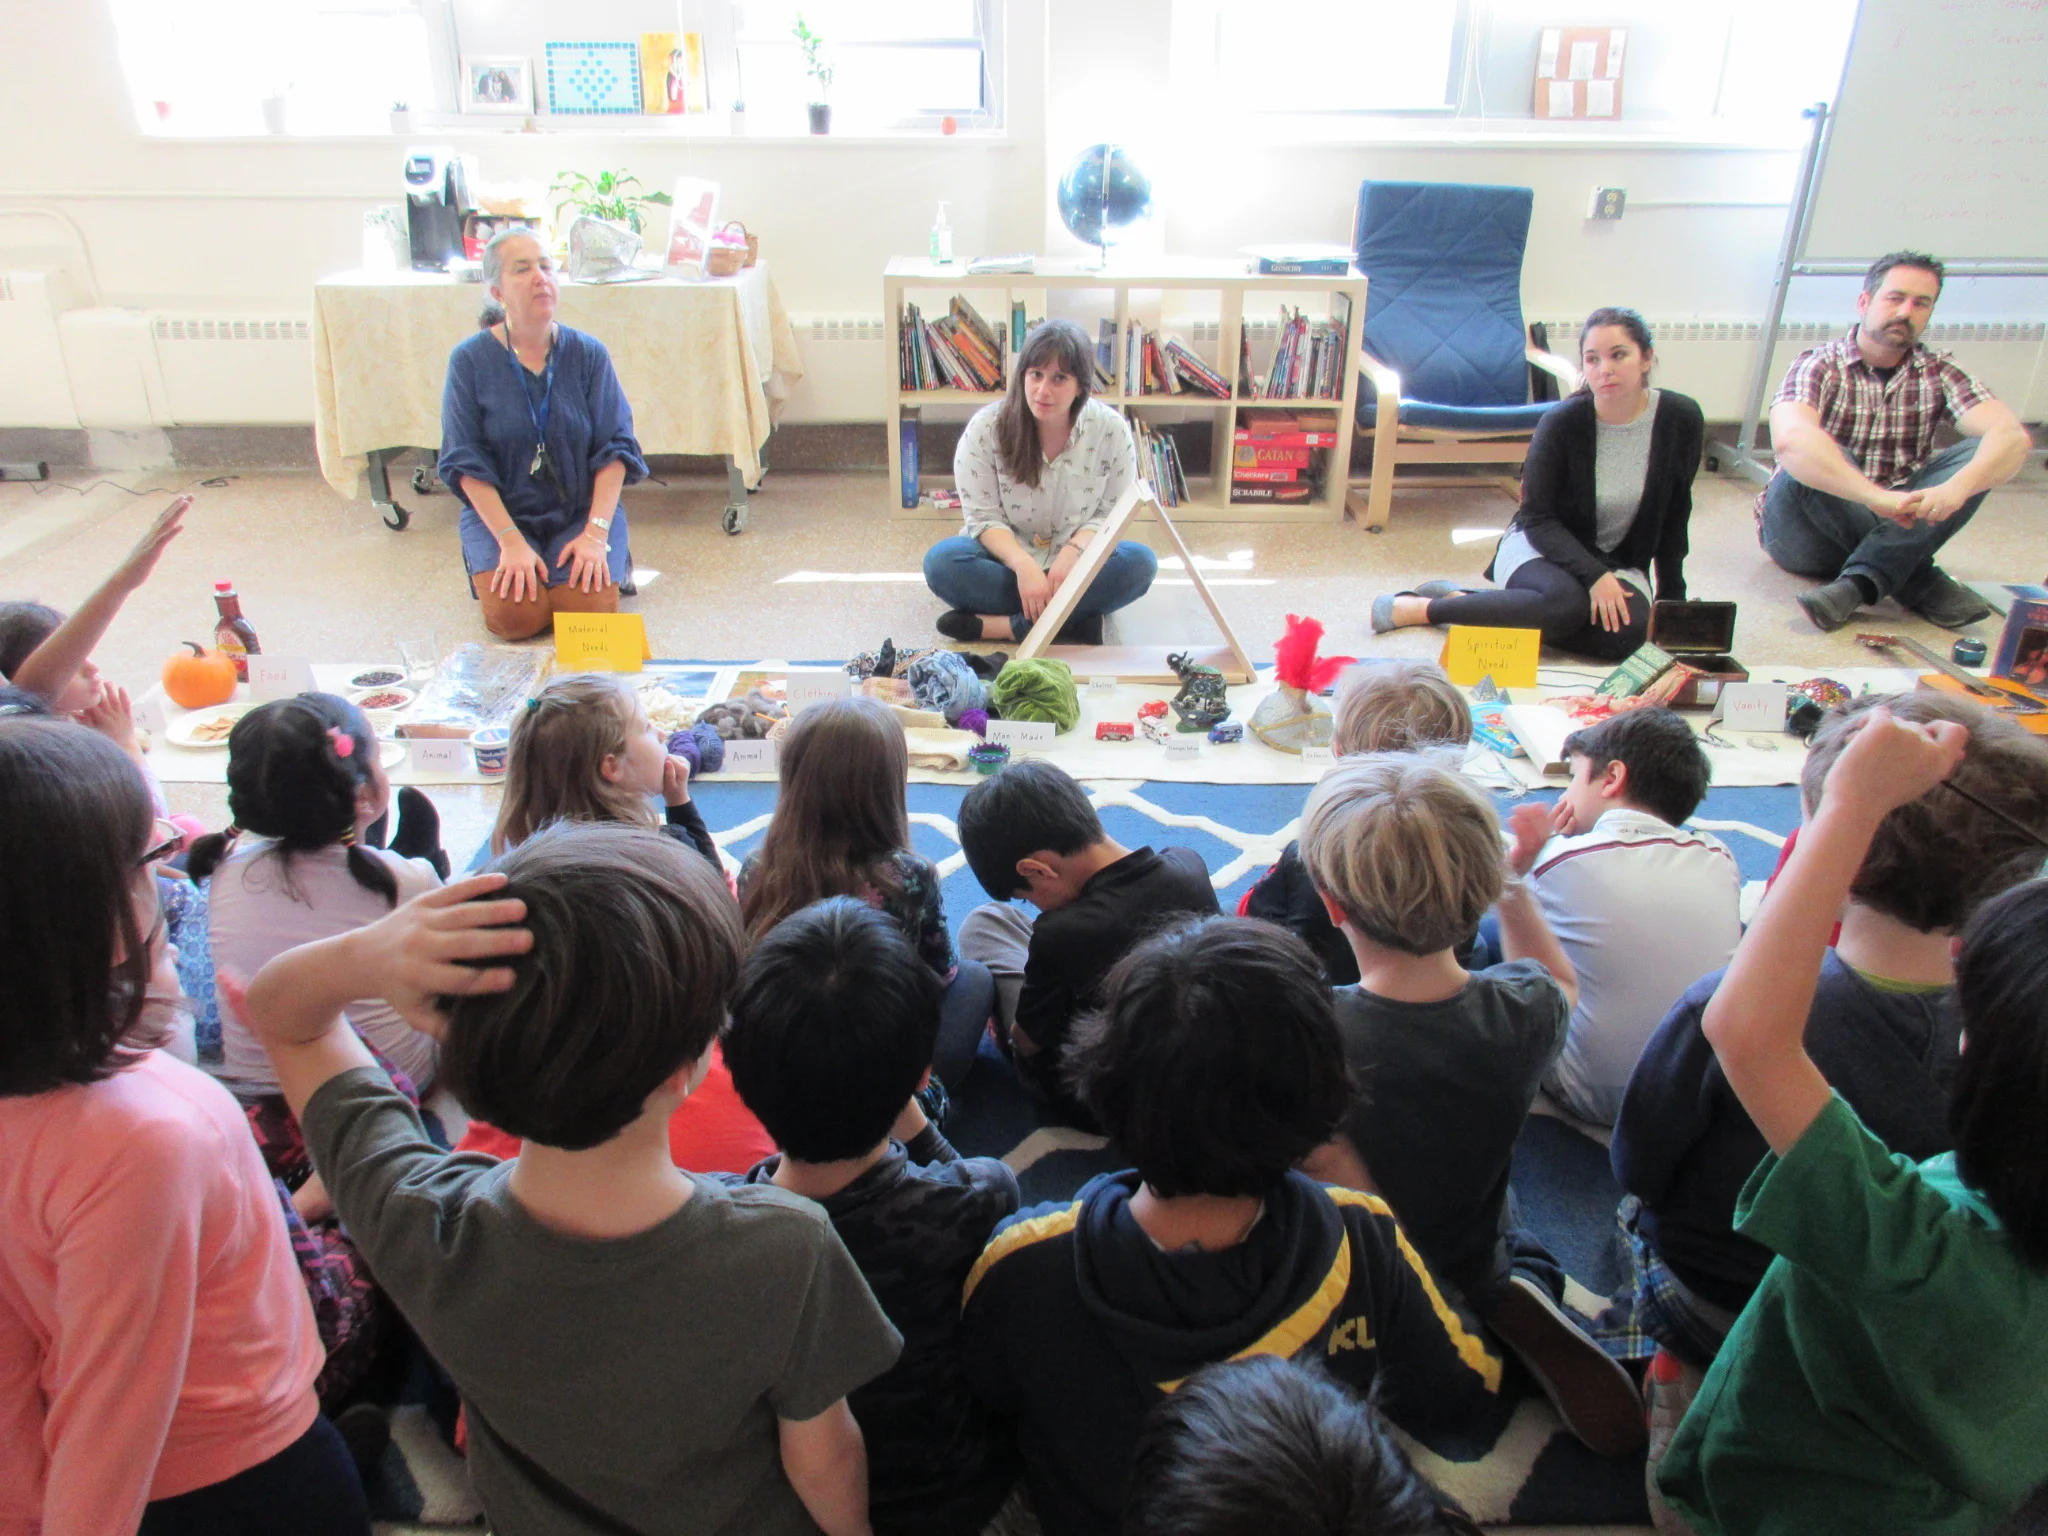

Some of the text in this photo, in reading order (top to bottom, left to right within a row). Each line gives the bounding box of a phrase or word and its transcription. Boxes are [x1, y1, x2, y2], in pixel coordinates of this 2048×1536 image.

[1257, 448, 1293, 461] CATAN
[1234, 471, 1270, 479] Checkers
[1232, 488, 1273, 497] SCRABBLE
[568, 623, 608, 635] Material
[582, 641, 608, 652] Needs
[1466, 637, 1519, 654] Spiritual
[1478, 658, 1509, 670] Needs
[260, 669, 287, 683] Food
[1733, 699, 1768, 715] Vanity
[422, 749, 452, 760] Animal
[733, 748, 762, 761] Animal
[1328, 1315, 1376, 1355] KL
